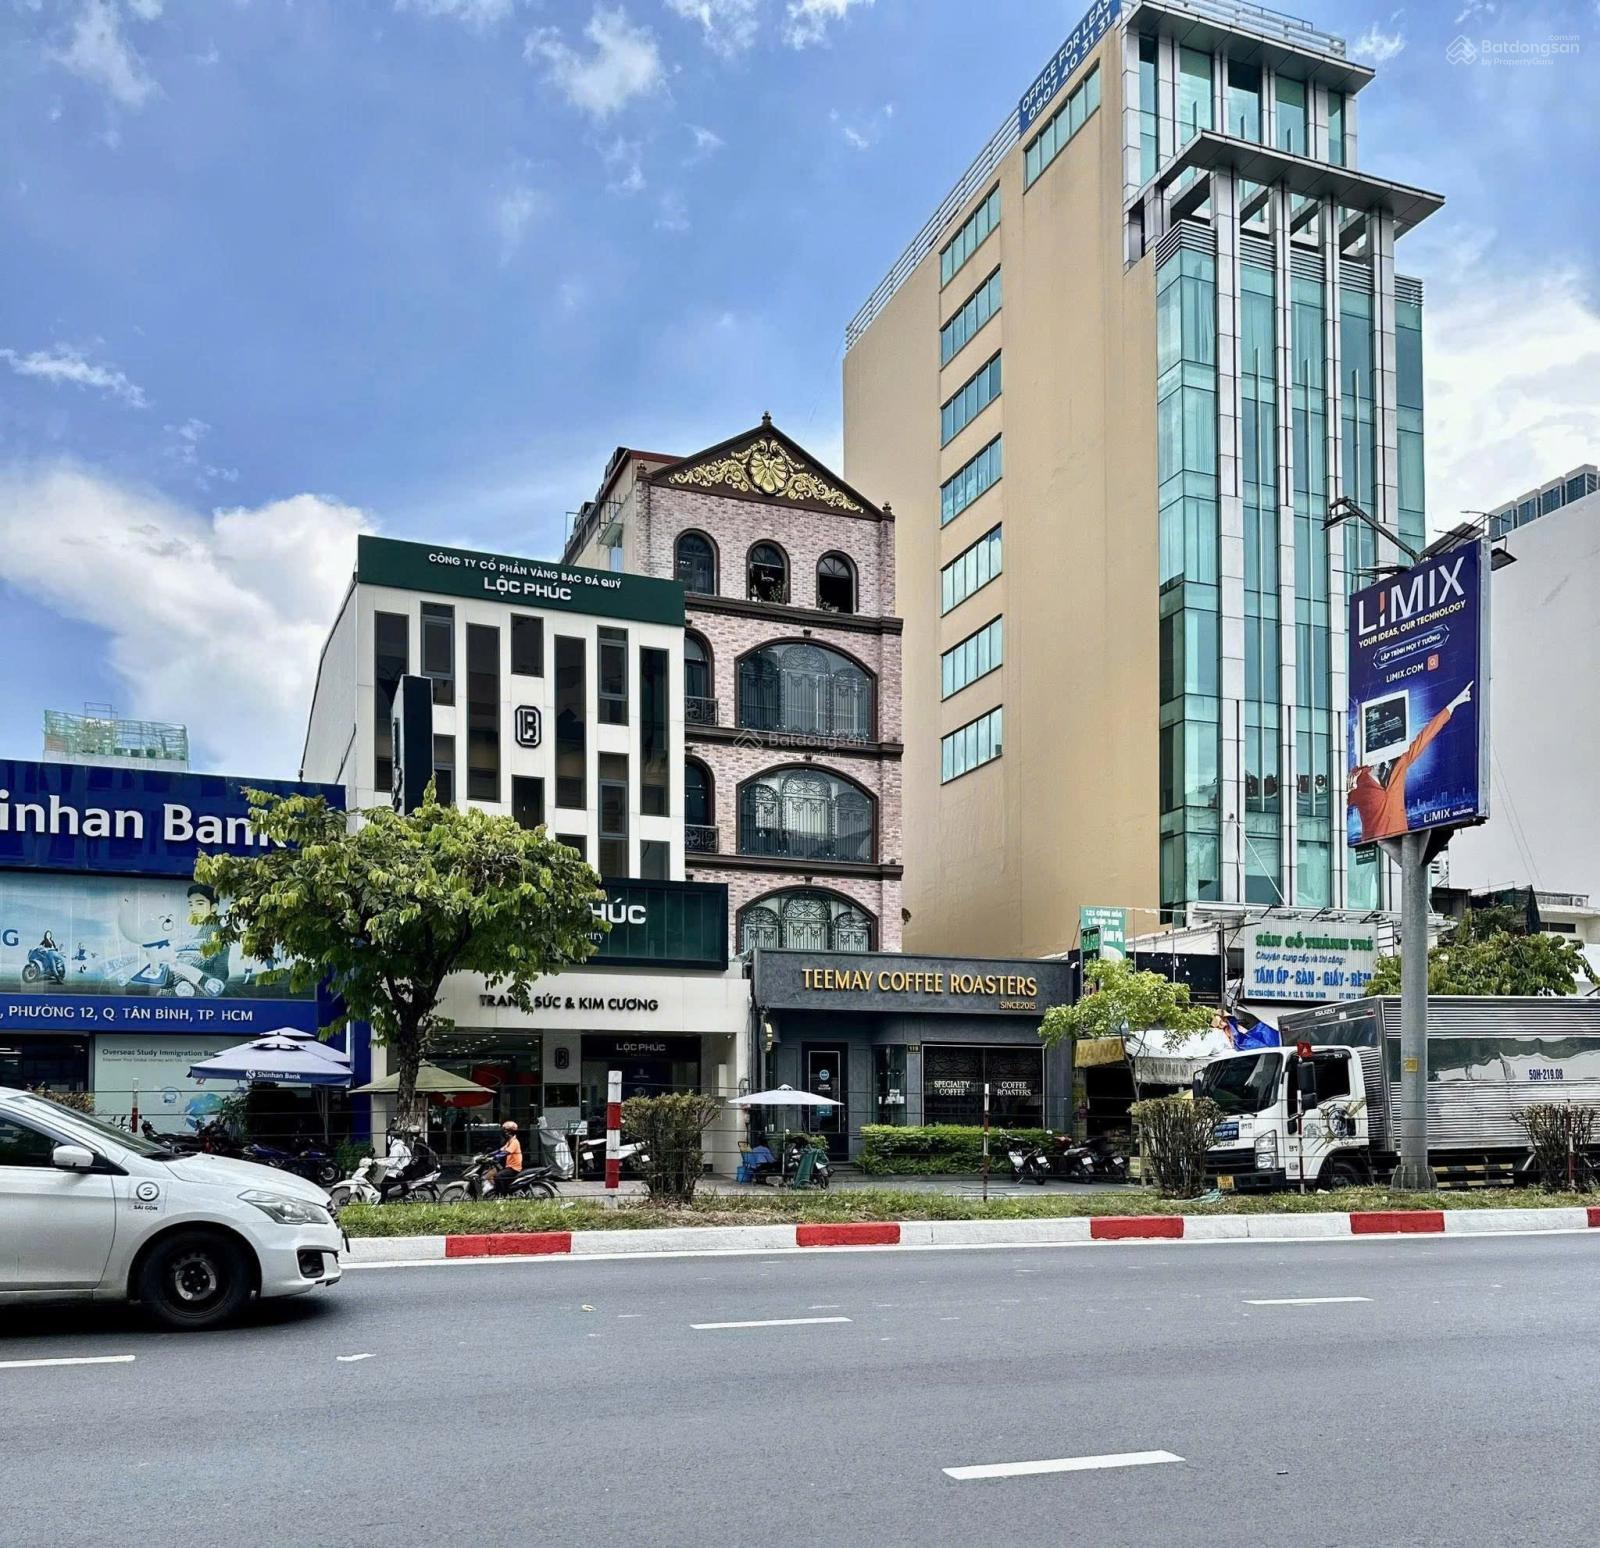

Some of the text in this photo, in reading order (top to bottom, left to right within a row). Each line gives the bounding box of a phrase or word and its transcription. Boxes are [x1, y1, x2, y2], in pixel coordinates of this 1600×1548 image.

[1022, 0, 1112, 113] OFFICE FOR LEAS
[1028, 76, 1059, 121] 0907
[428, 552, 622, 590] CÔNG TY CỔ PHẦN VÀNG BẠC ĐÁ QUÝ
[483, 574, 572, 601] LỘC PHÚC
[1358, 599, 1466, 649] YOUR IDEAS, OUR TECHNOLOGY
[588, 897, 647, 925] HÚC
[802, 968, 1038, 997] TEEMAY COFFEE ROASTERS
[534, 993, 562, 1009] SỨC
[565, 996, 576, 1009] &
[578, 996, 605, 1011] KIM
[608, 997, 659, 1012] CƯƠNG
[8, 1004, 75, 1018] PHƯỜNG
[79, 1007, 99, 1021] 12,
[122, 1005, 151, 1020] TÂN
[155, 1007, 194, 1022] BÌNH,
[221, 1010, 254, 1022] HCM
[102, 1048, 135, 1056] Overseas
[137, 1048, 158, 1057] Study
[159, 1049, 202, 1058] Immigration
[257, 1071, 284, 1080] Shinhan
[1528, 1068, 1564, 1081] 50H-219.08
[934, 1081, 971, 1089] SPECIALTY
[939, 1088, 966, 1097] COFFEE
[996, 1089, 1032, 1097] ROASTERS
[1001, 1081, 1028, 1090] COFFEE
